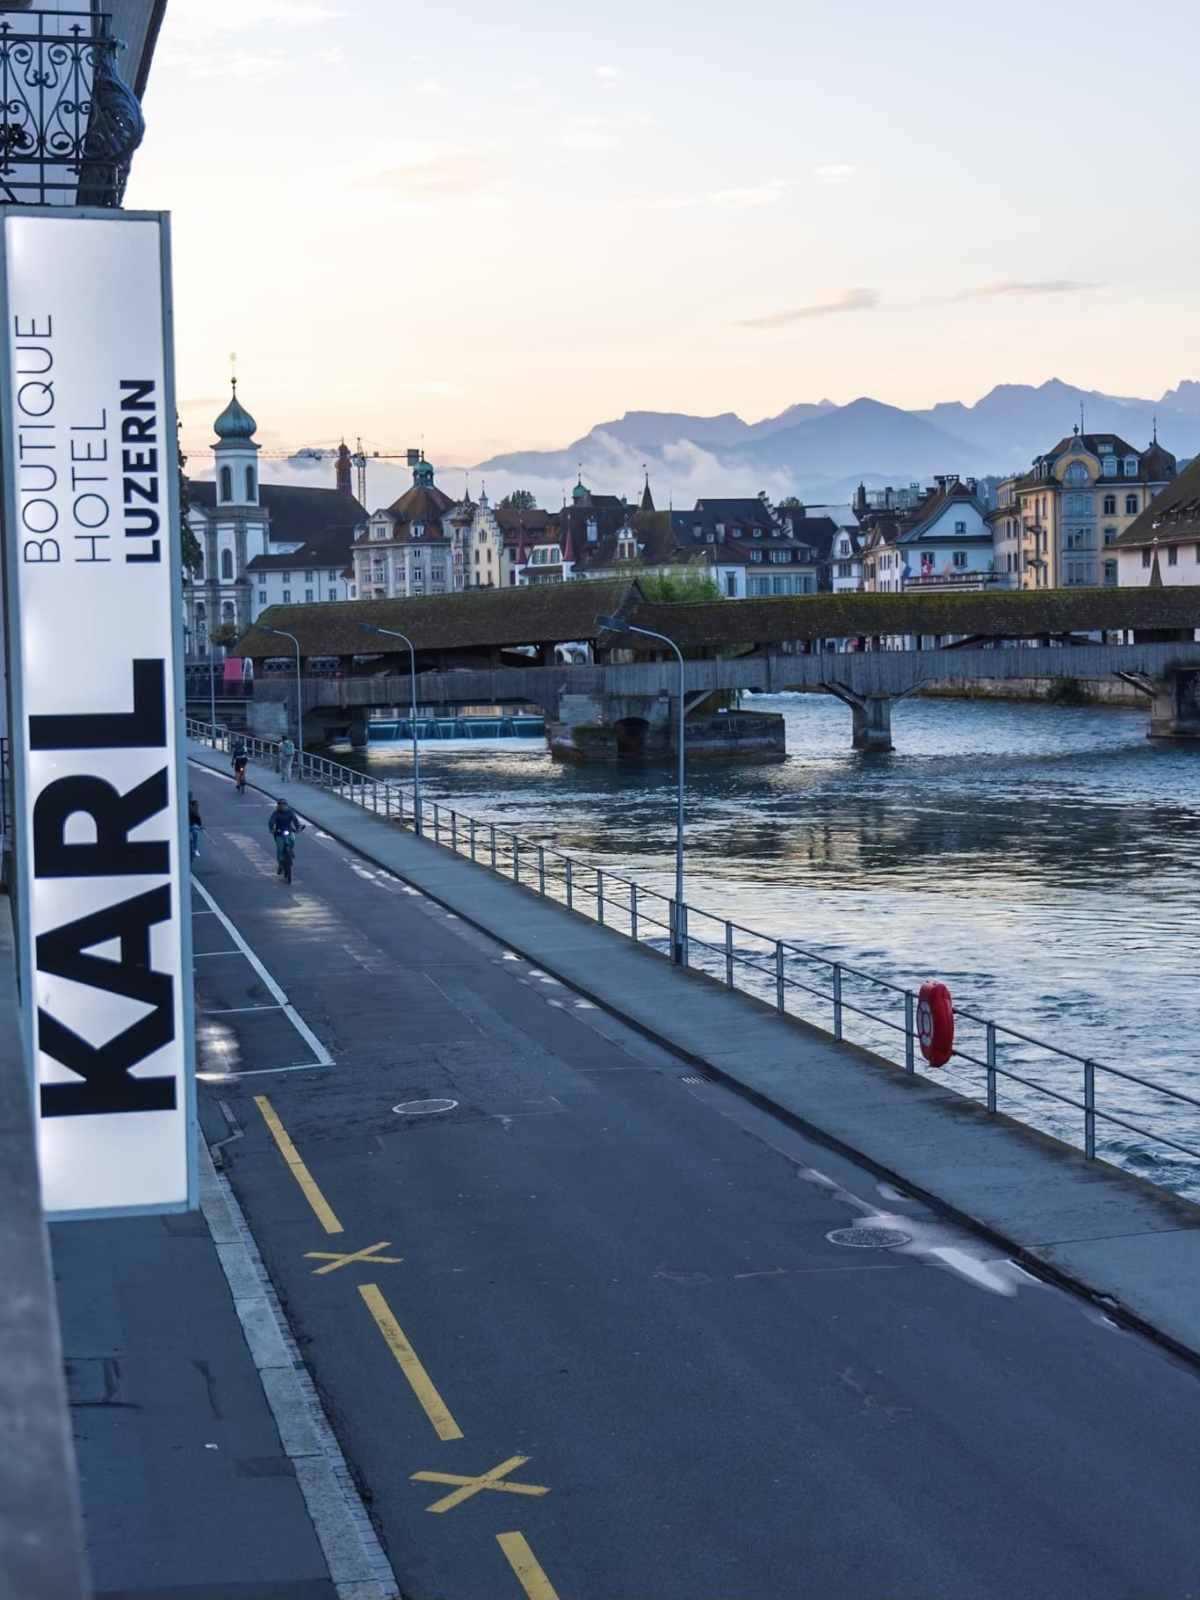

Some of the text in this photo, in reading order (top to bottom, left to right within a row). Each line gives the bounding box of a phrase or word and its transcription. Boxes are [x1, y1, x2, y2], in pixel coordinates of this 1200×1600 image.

[15, 314, 61, 564] BOUTIQUE
[70, 408, 112, 563] HOTEL
[120, 379, 162, 564] LUZERN
[28, 658, 177, 1118] KARL
